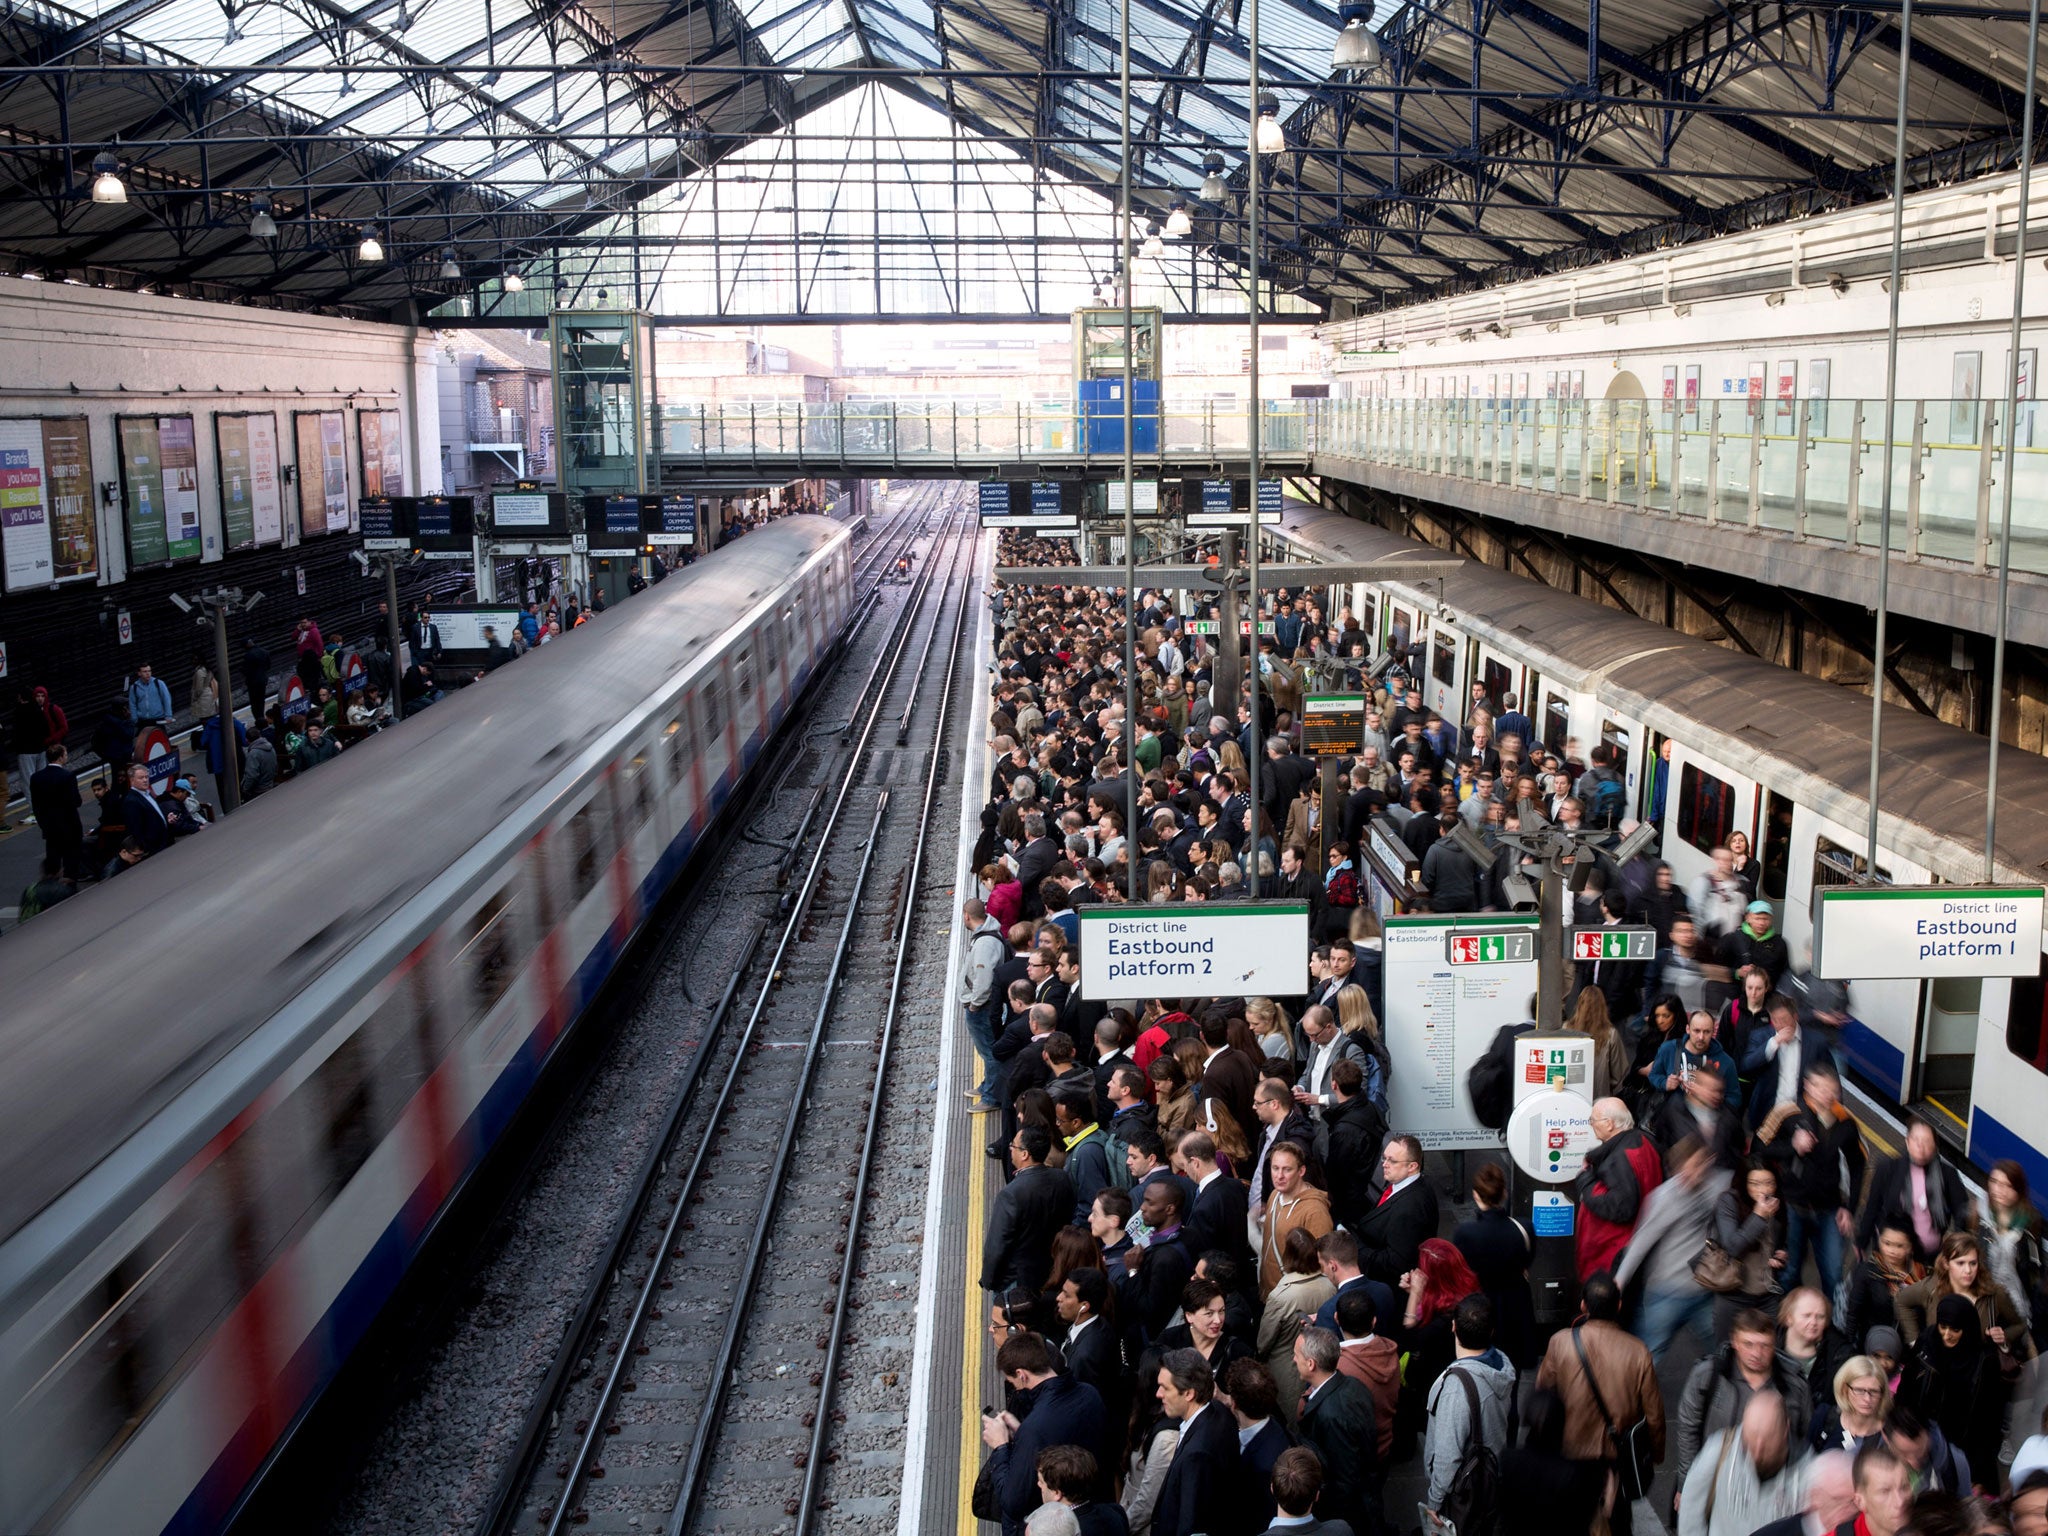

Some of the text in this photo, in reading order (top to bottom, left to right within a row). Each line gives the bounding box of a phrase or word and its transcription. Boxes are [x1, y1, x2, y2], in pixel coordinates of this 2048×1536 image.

[5, 453, 27, 465] Brands
[7, 471, 38, 486] you know.
[9, 492, 36, 505] Rewards
[55, 495, 83, 516] FAMILY
[10, 509, 27, 524] you'll
[576, 535, 584, 543] H
[158, 757, 176, 773] COURT
[1943, 903, 2017, 914] District line
[1108, 922, 1187, 933] District line
[1917, 919, 2017, 935] Eastbound
[1108, 938, 1213, 955] Eastbound
[1920, 940, 2015, 960] platform 1
[1109, 959, 1212, 980] platform 2
[1546, 1118, 1590, 1127] Help Point
